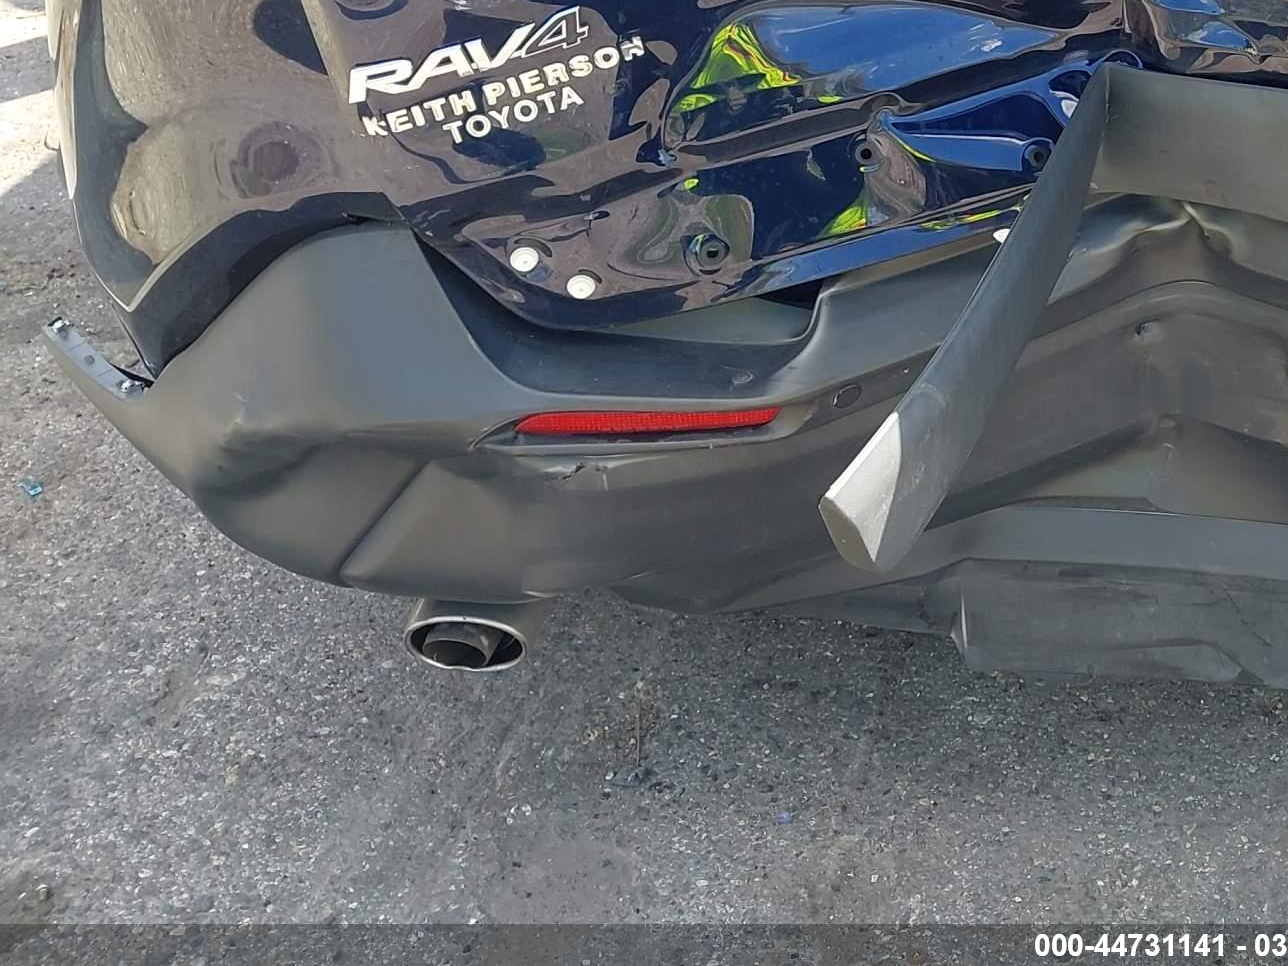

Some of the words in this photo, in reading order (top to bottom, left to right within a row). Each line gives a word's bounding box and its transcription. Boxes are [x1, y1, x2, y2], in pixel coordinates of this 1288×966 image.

[348, 5, 589, 104] RAV4
[362, 88, 477, 137] KEITH
[482, 35, 645, 106] PIERSON
[442, 86, 584, 144] TOYOTA
